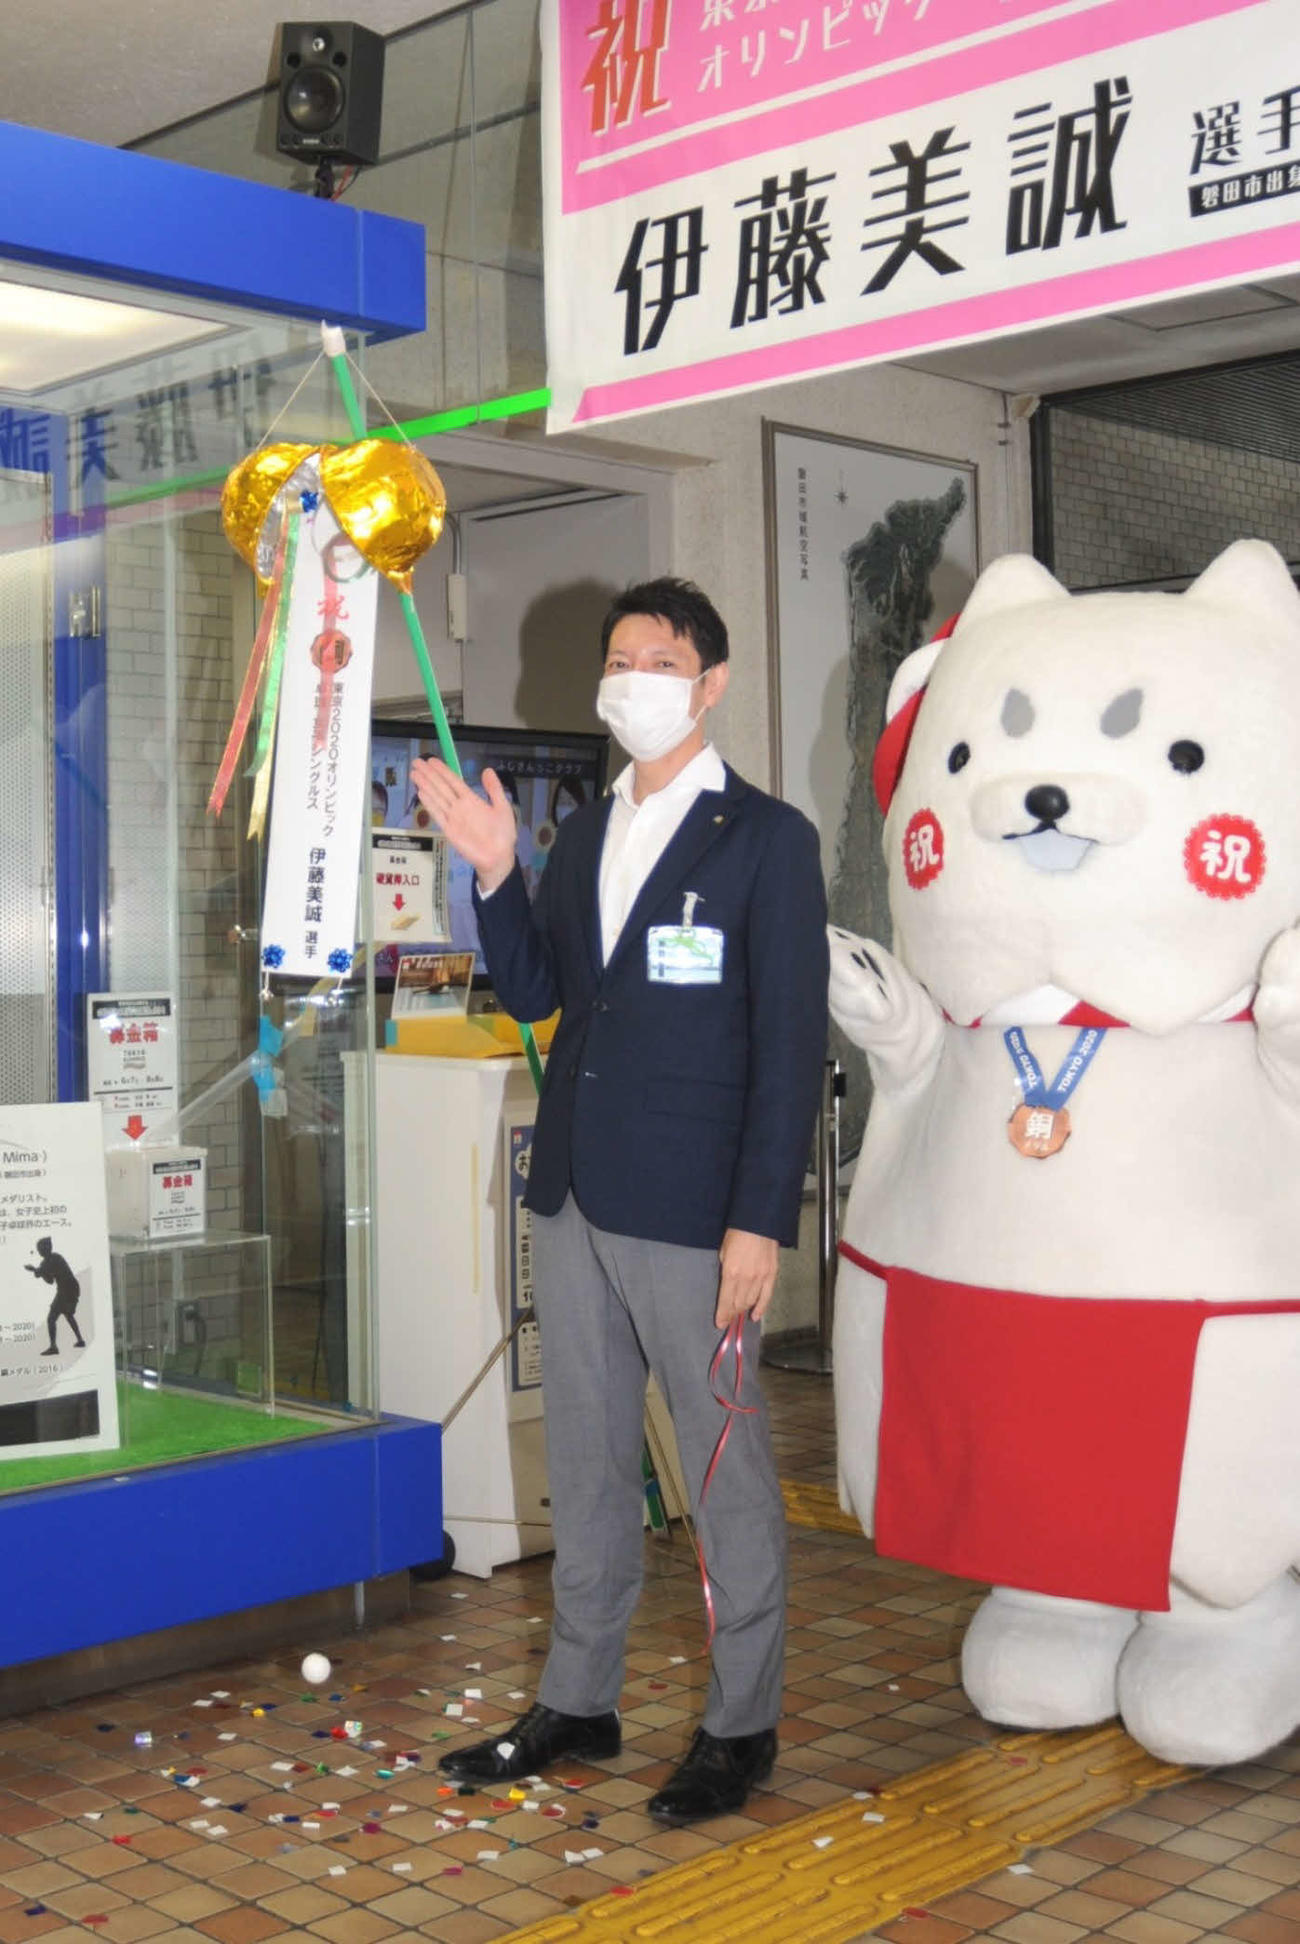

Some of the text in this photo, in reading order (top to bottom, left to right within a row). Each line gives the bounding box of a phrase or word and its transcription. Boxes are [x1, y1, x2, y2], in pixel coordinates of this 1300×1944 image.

[614, 74, 1133, 356] 伊藤美誠
[909, 824, 940, 872] 祝
[1200, 829, 1252, 884] 祝
[1057, 1055, 1083, 1092] TOKYO
